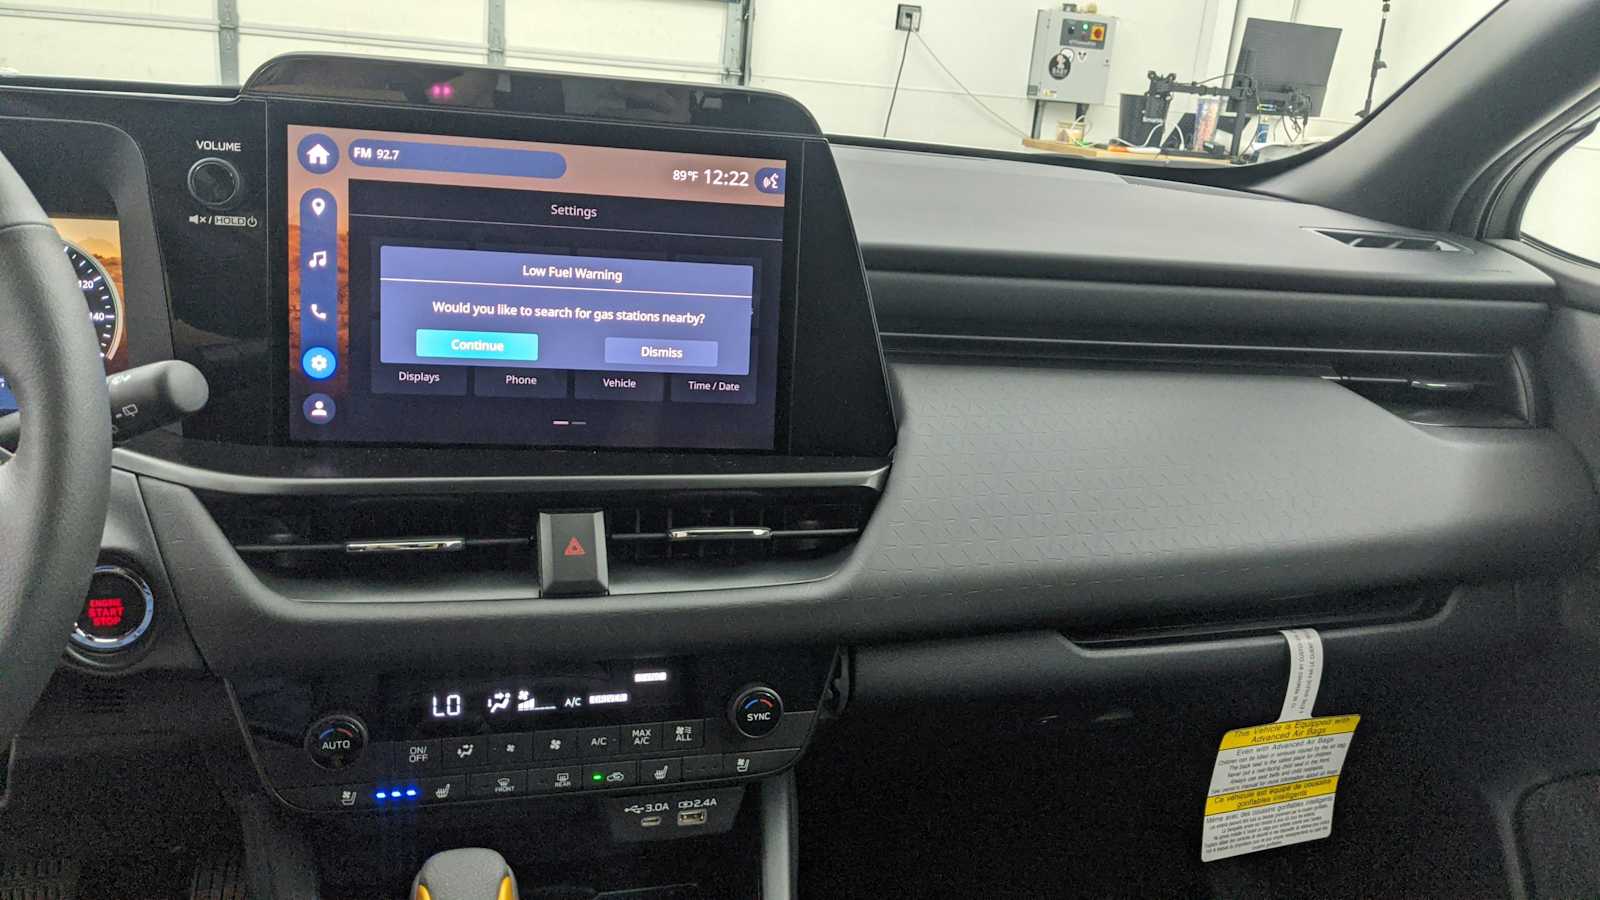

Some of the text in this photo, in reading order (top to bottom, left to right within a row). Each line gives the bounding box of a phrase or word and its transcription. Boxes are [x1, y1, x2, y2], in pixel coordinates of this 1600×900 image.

[196, 140, 242, 152] VOLUME
[353, 147, 400, 160] FM 92.7
[672, 169, 749, 187] 89°F 12:22
[550, 204, 598, 220] Settings
[215, 215, 246, 227] HOLD
[522, 264, 623, 283] Low Fuel Warning
[78, 280, 94, 290] 120
[432, 301, 705, 326] Would you like to search for gas stations nearby?
[451, 339, 504, 352] Continue
[641, 346, 683, 359] Dismiss
[398, 371, 440, 384] Displays
[505, 375, 537, 385] Phone
[603, 378, 637, 388] Vehicle
[688, 381, 711, 391] Time
[718, 382, 740, 392] Date
[88, 607, 125, 618] START
[93, 617, 121, 626] STOP
[432, 694, 461, 717] LO
[565, 697, 581, 708] A/C
[747, 712, 771, 721] SYNC
[1254, 725, 1282, 734] Vehicle
[1295, 719, 1332, 730] Equipped
[632, 729, 651, 738] MAX
[675, 733, 693, 742] ALL
[1251, 727, 1326, 743] Advanced Air Bags
[321, 740, 350, 750] AUTO
[591, 737, 607, 746] A/C
[634, 736, 650, 745] A/C
[410, 746, 427, 755] ON/
[1236, 748, 1253, 756] Even
[1271, 740, 1304, 750] Advanced
[1318, 737, 1334, 745] Bags
[409, 754, 428, 763] OFF
[495, 785, 515, 793] FRONT
[554, 780, 571, 788] REAR
[645, 803, 670, 813] 3.0A
[693, 798, 717, 808] 2.4A
